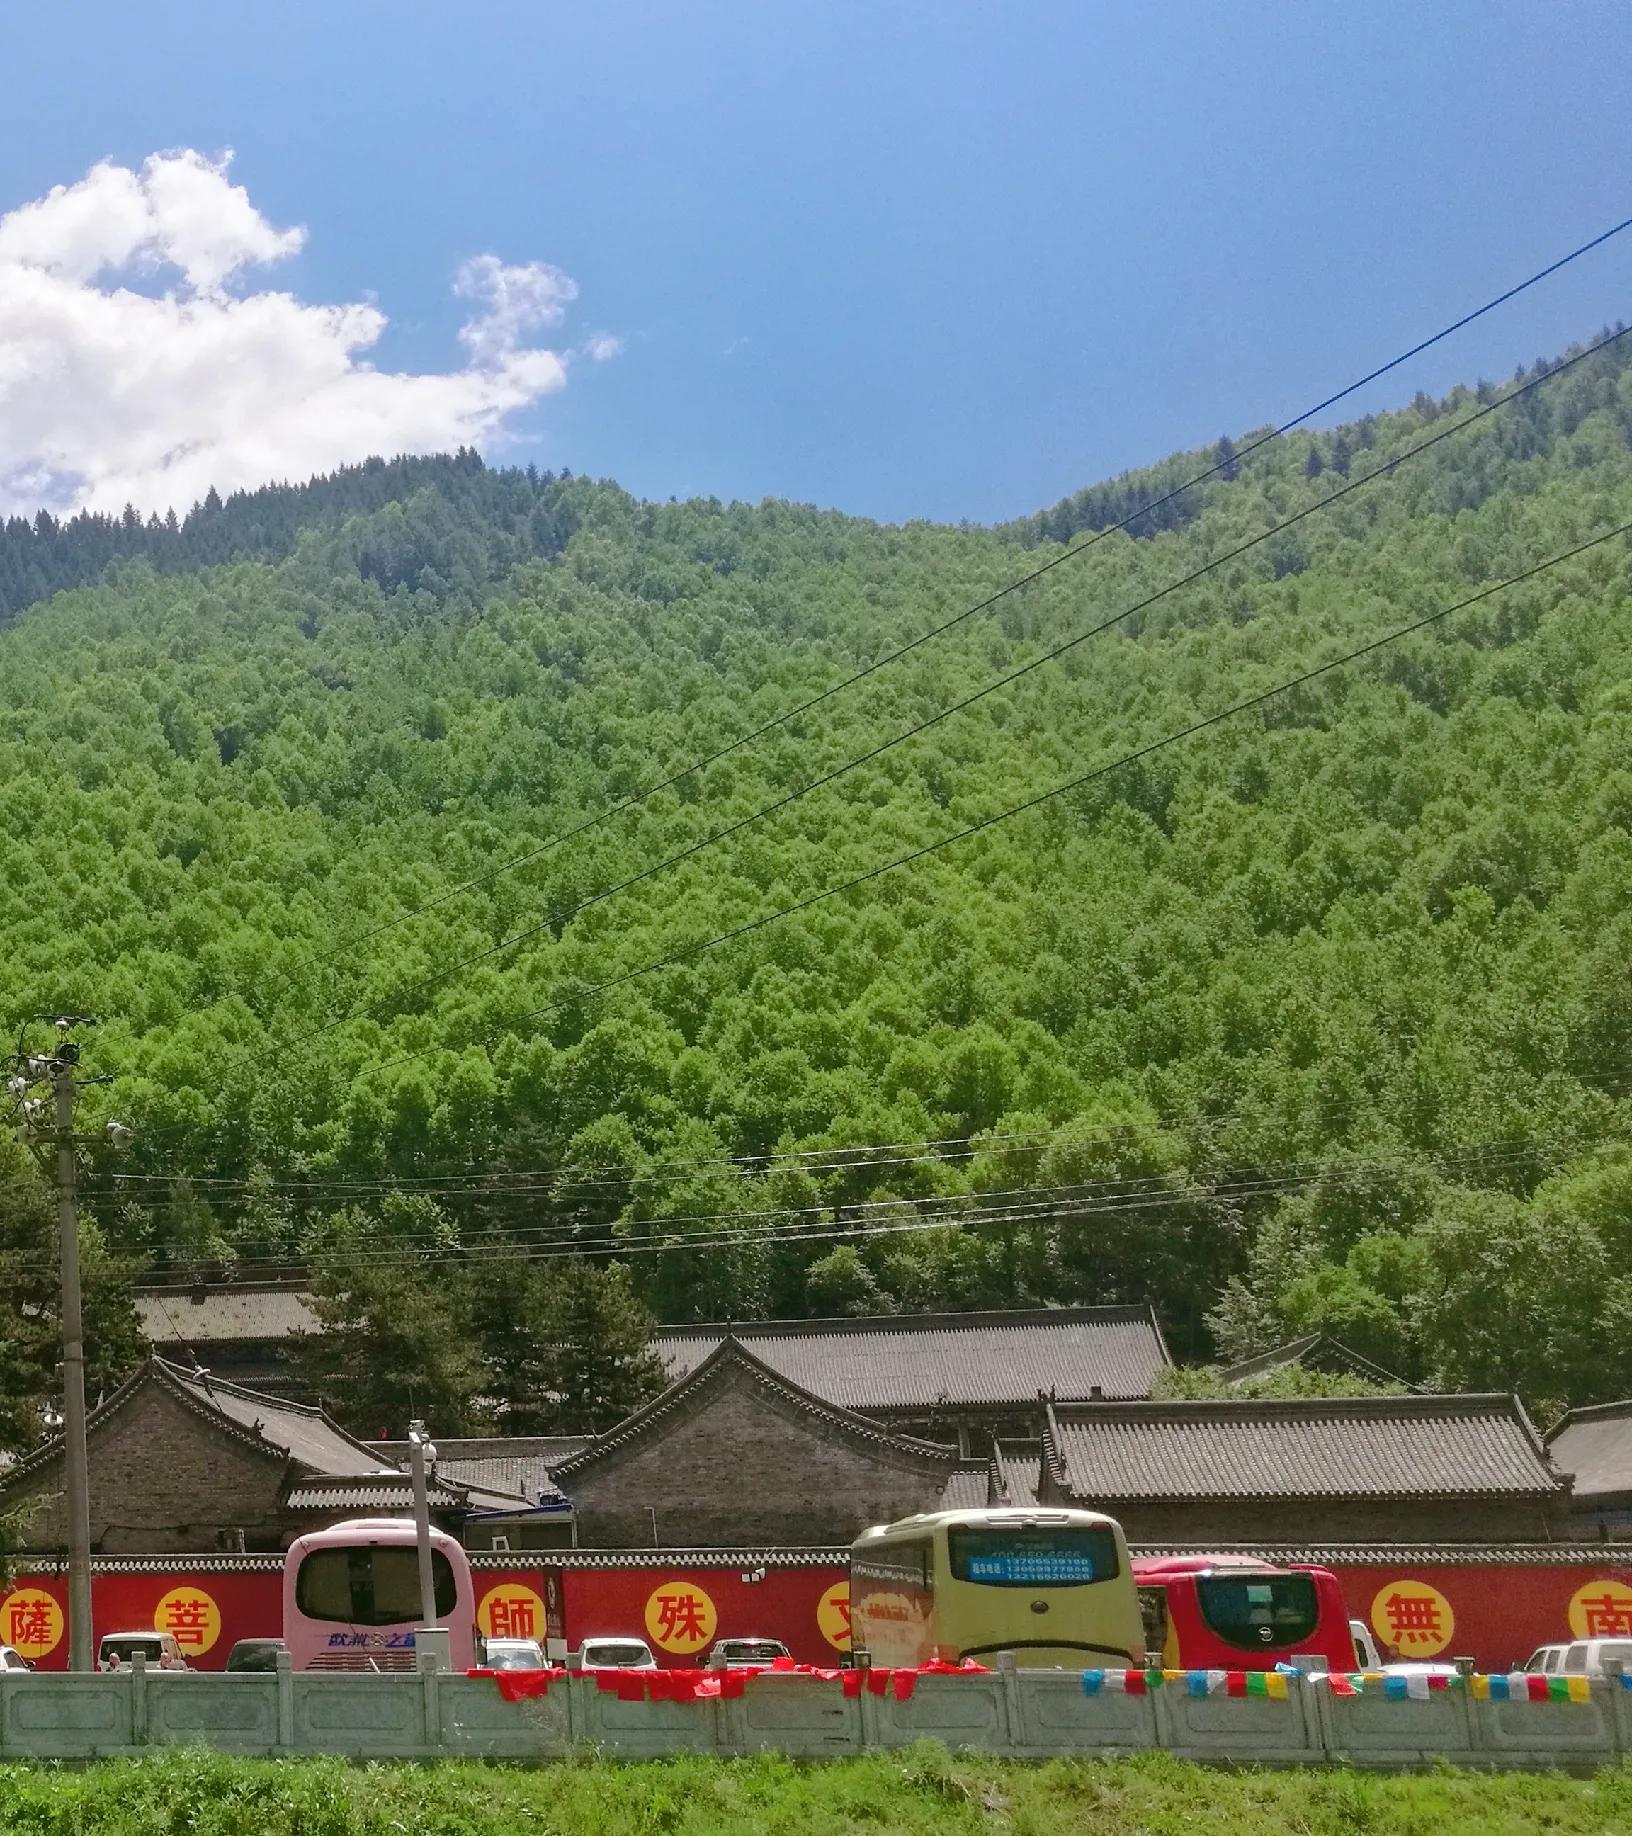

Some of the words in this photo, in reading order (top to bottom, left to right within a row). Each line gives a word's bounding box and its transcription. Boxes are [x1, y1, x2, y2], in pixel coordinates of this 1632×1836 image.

[9, 1599, 53, 1645] 薩
[166, 1600, 210, 1645] 菩
[489, 1597, 534, 1639] 師
[657, 1595, 707, 1642] 殊
[1386, 1593, 1444, 1643] 無
[1581, 1594, 1632, 1637] 南
